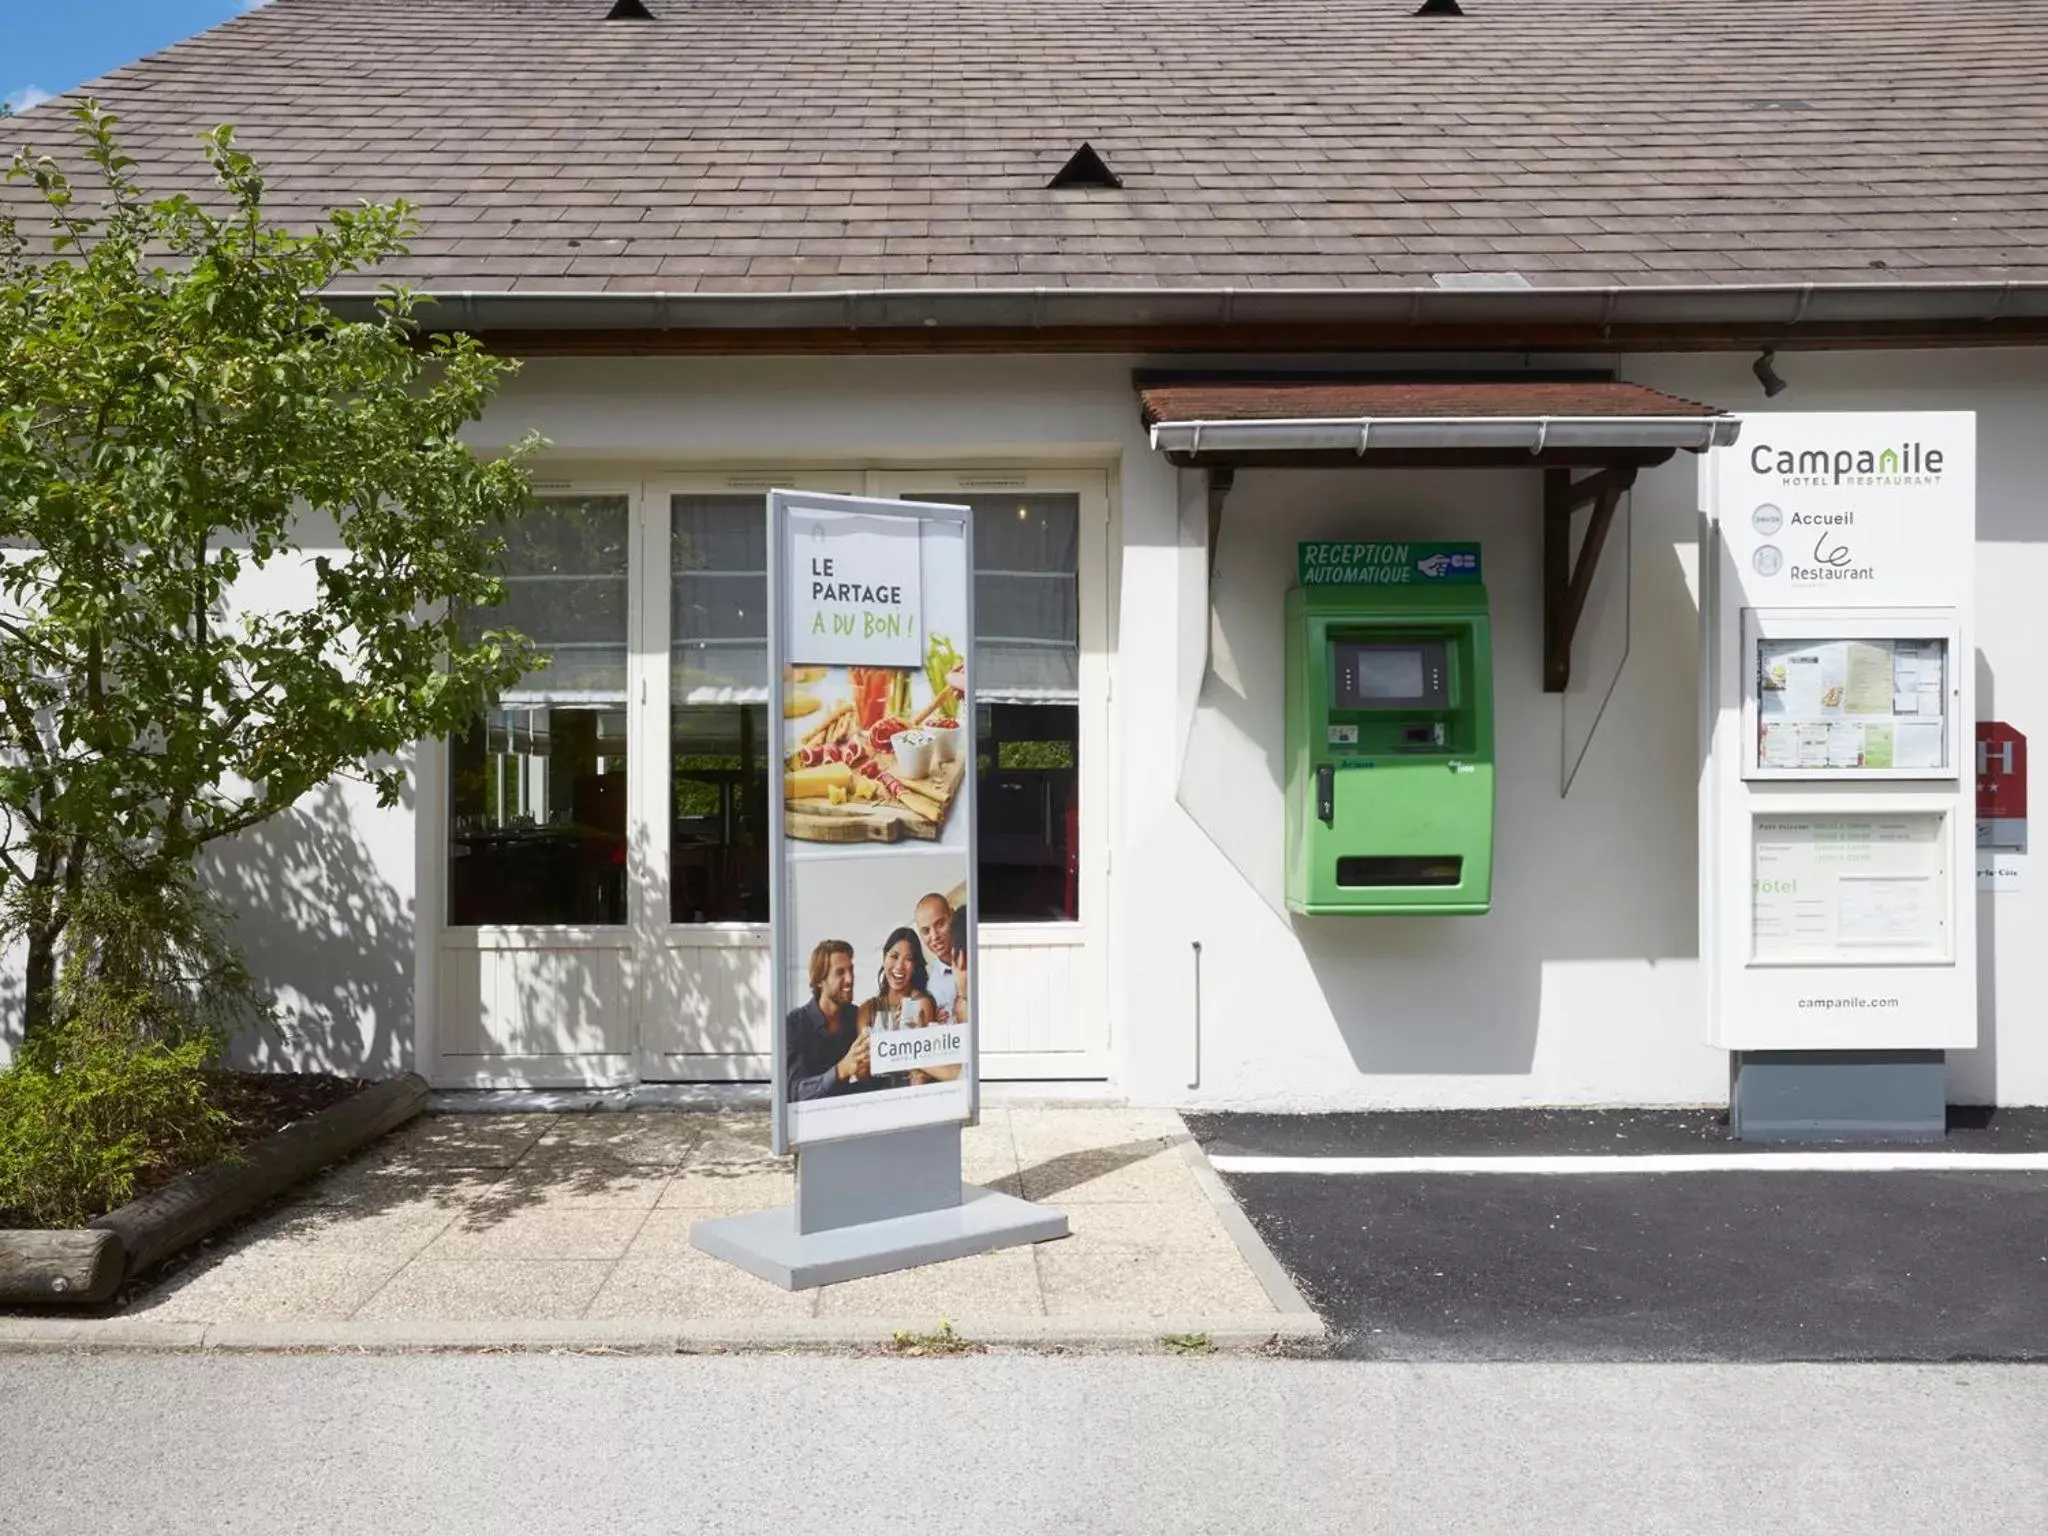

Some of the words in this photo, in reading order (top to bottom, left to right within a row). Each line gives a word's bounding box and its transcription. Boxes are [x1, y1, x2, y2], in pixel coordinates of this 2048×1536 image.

[1750, 442, 1944, 485] Campanile
[1782, 477, 1828, 486] HOTEL
[1847, 476, 1942, 486] RESTAURANT
[1790, 512, 1853, 525] Accueil
[1304, 544, 1410, 565] RECEPTION
[1814, 531, 1852, 567] Le
[812, 557, 834, 577] LE
[1304, 565, 1411, 583] AUTOMATIQUE
[1790, 566, 1874, 581] Restaurant
[812, 581, 902, 604] PARTAGE
[812, 610, 826, 635] A
[832, 612, 856, 636] DU
[907, 614, 914, 638] !
[1976, 740, 2013, 774] H
[1797, 997, 1899, 1009] campanile.com
[877, 1031, 961, 1060] Campanile
